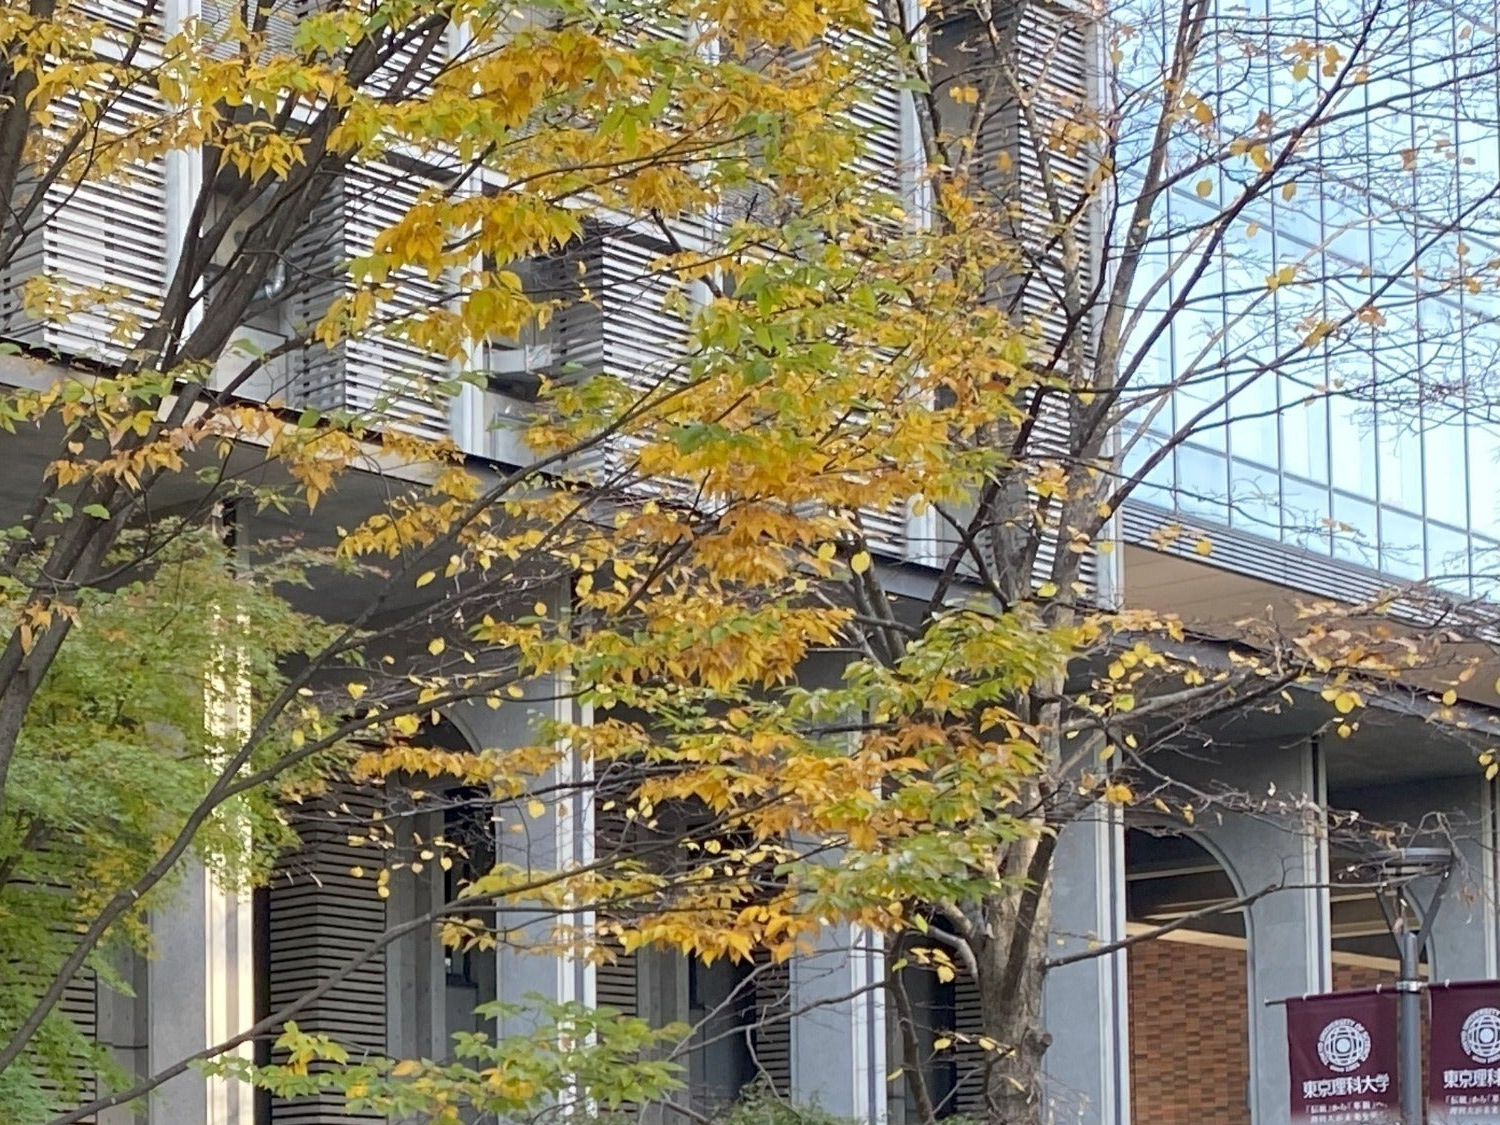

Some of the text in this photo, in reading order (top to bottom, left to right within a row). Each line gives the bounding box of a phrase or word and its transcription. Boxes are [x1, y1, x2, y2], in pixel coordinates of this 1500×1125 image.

[1303, 1073, 1390, 1099] 東京理科大学
